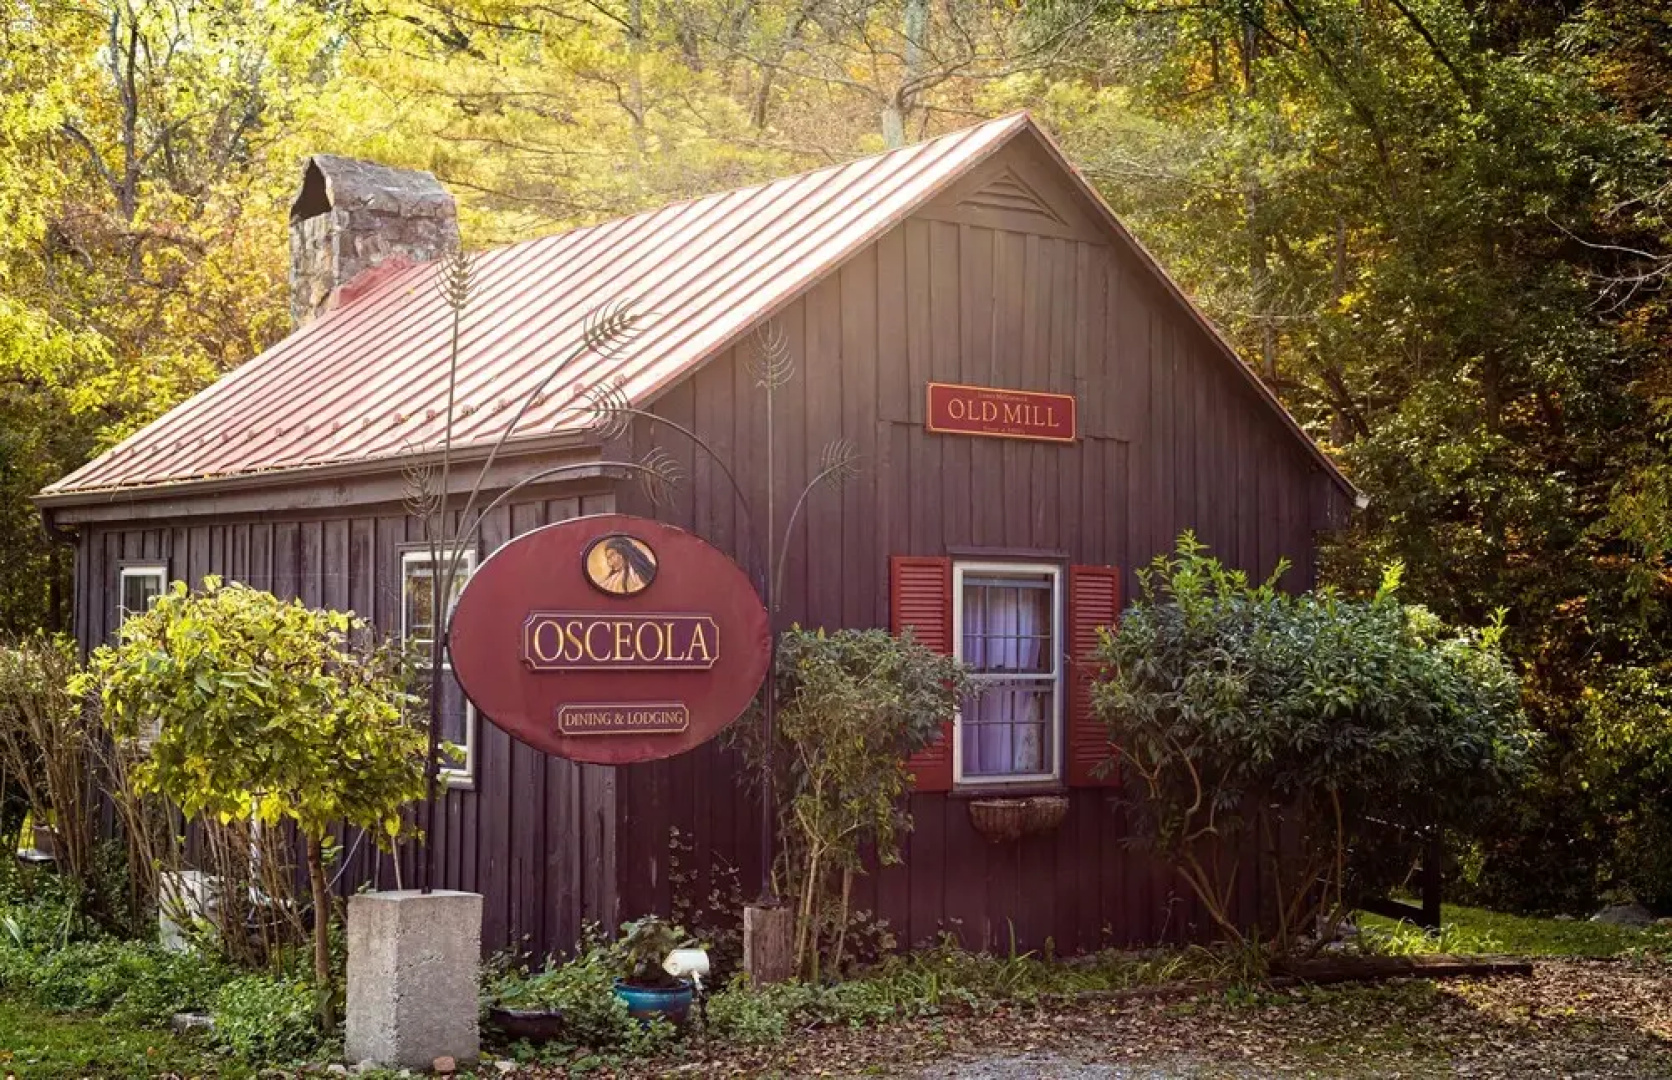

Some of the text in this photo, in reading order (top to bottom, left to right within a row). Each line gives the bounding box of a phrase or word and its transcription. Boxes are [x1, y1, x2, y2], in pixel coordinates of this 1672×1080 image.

[947, 398, 1060, 427] OLD MILL
[533, 620, 712, 662] OSCEOLA
[565, 711, 683, 727] DINING & LODGING
